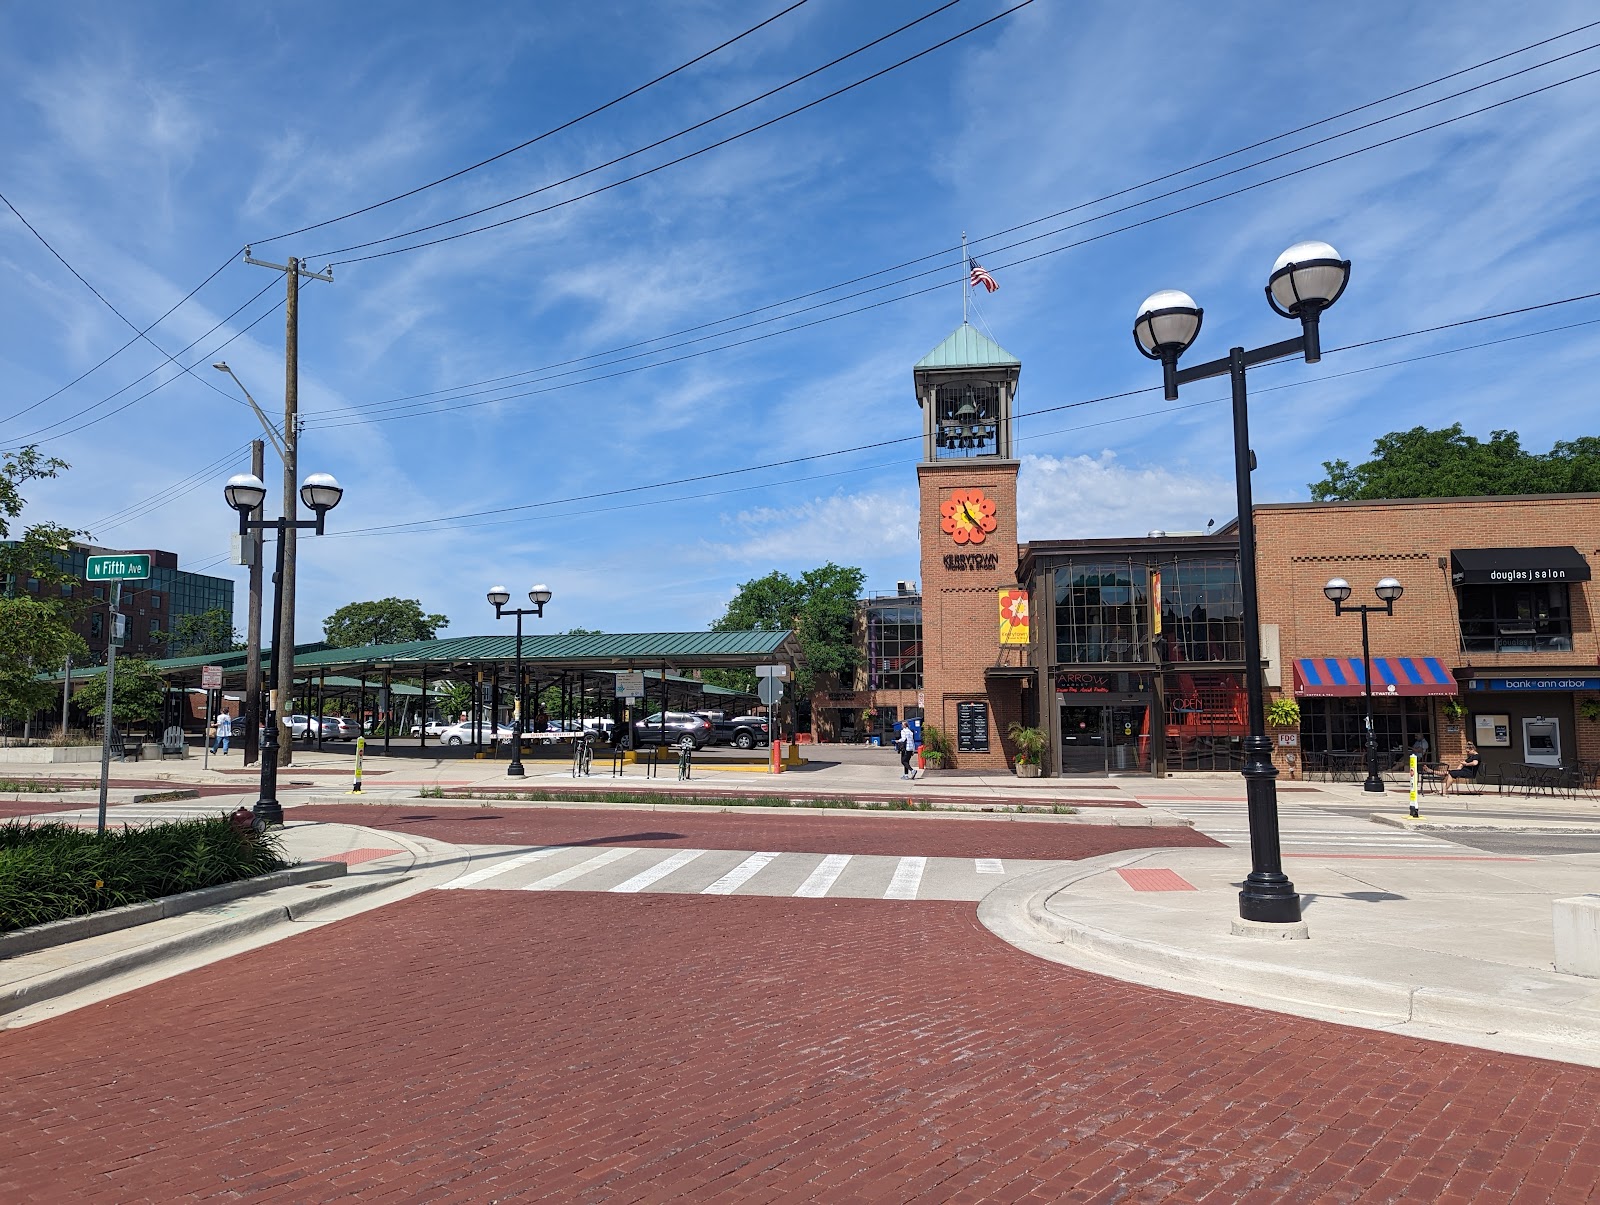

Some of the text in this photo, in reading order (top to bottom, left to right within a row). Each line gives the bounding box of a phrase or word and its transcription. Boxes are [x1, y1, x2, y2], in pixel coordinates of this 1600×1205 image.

[94, 561, 142, 575] N Fifth Ave
[1490, 570, 1527, 581] douglas
[1534, 569, 1565, 579] salon
[1505, 680, 1531, 688] bank
[1537, 680, 1557, 688] ann
[1558, 679, 1586, 688] arbor
[1173, 698, 1203, 711] OPEN
